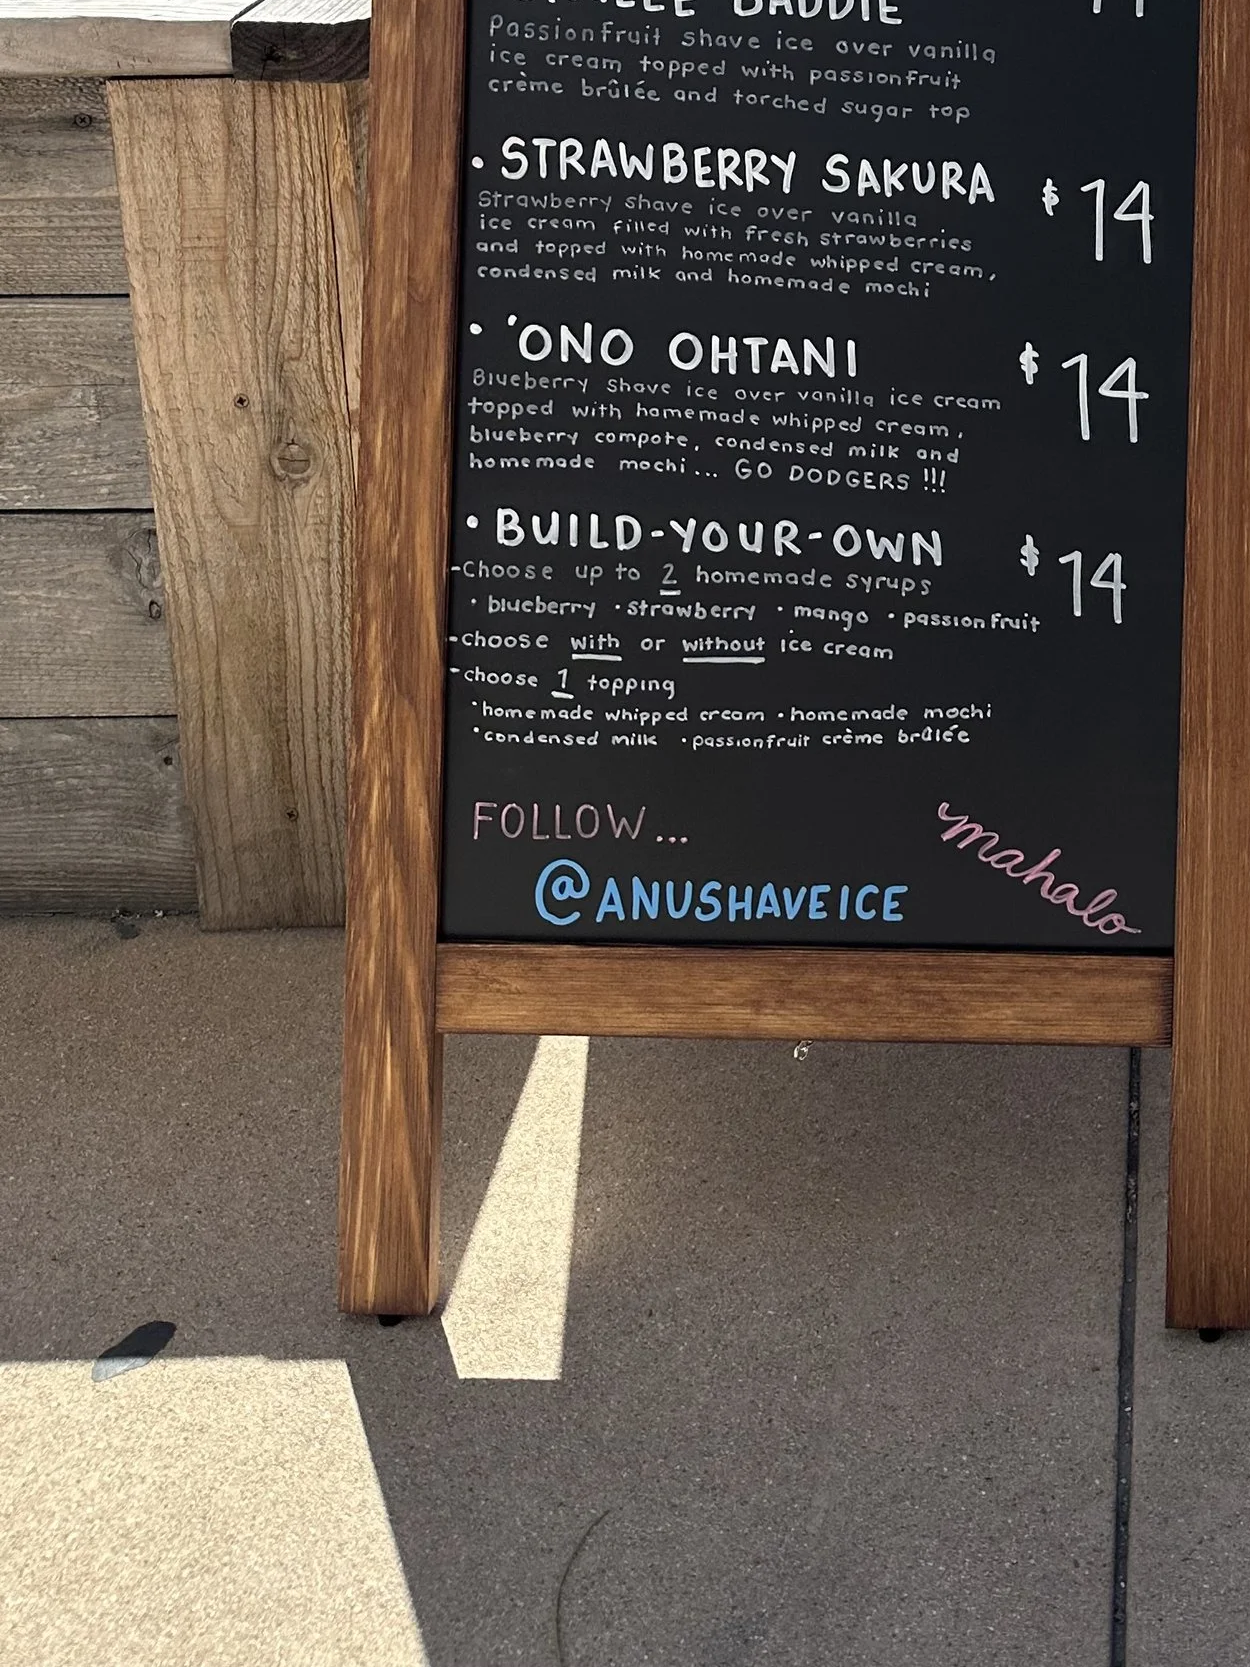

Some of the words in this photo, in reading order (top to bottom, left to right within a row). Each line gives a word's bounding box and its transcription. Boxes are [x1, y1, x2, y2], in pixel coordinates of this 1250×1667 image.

[490, 43, 526, 65] ice
[546, 54, 621, 73] cream
[640, 56, 725, 79] topped
[742, 60, 794, 81] with
[681, 29, 760, 49] shave
[777, 31, 813, 51] ice
[836, 41, 892, 56] over
[909, 40, 995, 63] vanilla
[489, 71, 563, 93] crème
[582, 78, 660, 101] brûlée
[674, 87, 716, 102] and
[734, 89, 826, 114] torched
[841, 102, 912, 122] sugar
[929, 105, 970, 124] top
[502, 137, 796, 194] STRAWBERRY
[822, 154, 995, 204] SAKURA
[479, 191, 611, 212] Strawberry
[625, 194, 692, 214] shave
[710, 198, 741, 216] ice
[758, 207, 812, 222] over
[832, 209, 916, 227] vanilla
[481, 214, 511, 230] ice
[528, 218, 595, 230] cream
[614, 219, 668, 234] filled
[685, 226, 731, 239] with
[745, 225, 808, 246] fresh
[820, 229, 971, 251] strawberries
[476, 239, 518, 253] and
[536, 241, 605, 258] topped
[622, 245, 666, 256] with
[682, 246, 795, 266] homemade
[811, 255, 898, 273] whipped
[911, 261, 995, 280] cream,
[478, 264, 596, 282] condensed
[613, 265, 660, 279] milk
[676, 268, 712, 281] and
[727, 268, 851, 295] homemade
[866, 282, 929, 297] mochi
[668, 331, 857, 378] OHTANI
[473, 368, 588, 393] Blueberry
[686, 380, 718, 400] ice
[735, 389, 785, 402] over
[798, 387, 873, 407] vanilla
[891, 387, 922, 405] ice
[934, 396, 1000, 409] cream
[468, 397, 553, 419] topped
[572, 404, 621, 420] with
[637, 403, 759, 425] homemade
[773, 413, 861, 433] whipped
[876, 420, 962, 438] cream,
[470, 425, 578, 445] blueberry
[595, 432, 699, 451] compote,
[715, 437, 833, 456] condensed
[849, 444, 899, 458] milk
[917, 448, 958, 463] and
[470, 453, 594, 468] homemade
[735, 458, 772, 479] GO
[789, 465, 909, 490] DODGERS
[576, 565, 603, 586] up
[616, 563, 640, 580] to
[662, 564, 677, 584] 2
[696, 565, 832, 587] homemade
[846, 574, 931, 596] syrups
[488, 595, 595, 618] blueberry
[627, 600, 755, 620] strawberry
[795, 606, 868, 631] mango
[571, 634, 619, 650] with
[641, 638, 665, 650] or
[682, 637, 765, 652] without
[781, 630, 812, 652] ice
[824, 643, 893, 659] cream
[558, 669, 567, 688] 1
[588, 675, 674, 699] topping
[483, 701, 593, 720] homemade
[605, 707, 687, 726] whipped
[700, 710, 764, 721] cream
[791, 704, 908, 721] homemade
[924, 704, 991, 719] mochi
[485, 731, 598, 745] condensed
[612, 733, 657, 746] milk
[823, 728, 883, 744] crème
[898, 725, 969, 743] brûlée
[938, 802, 1141, 934] mahalo
